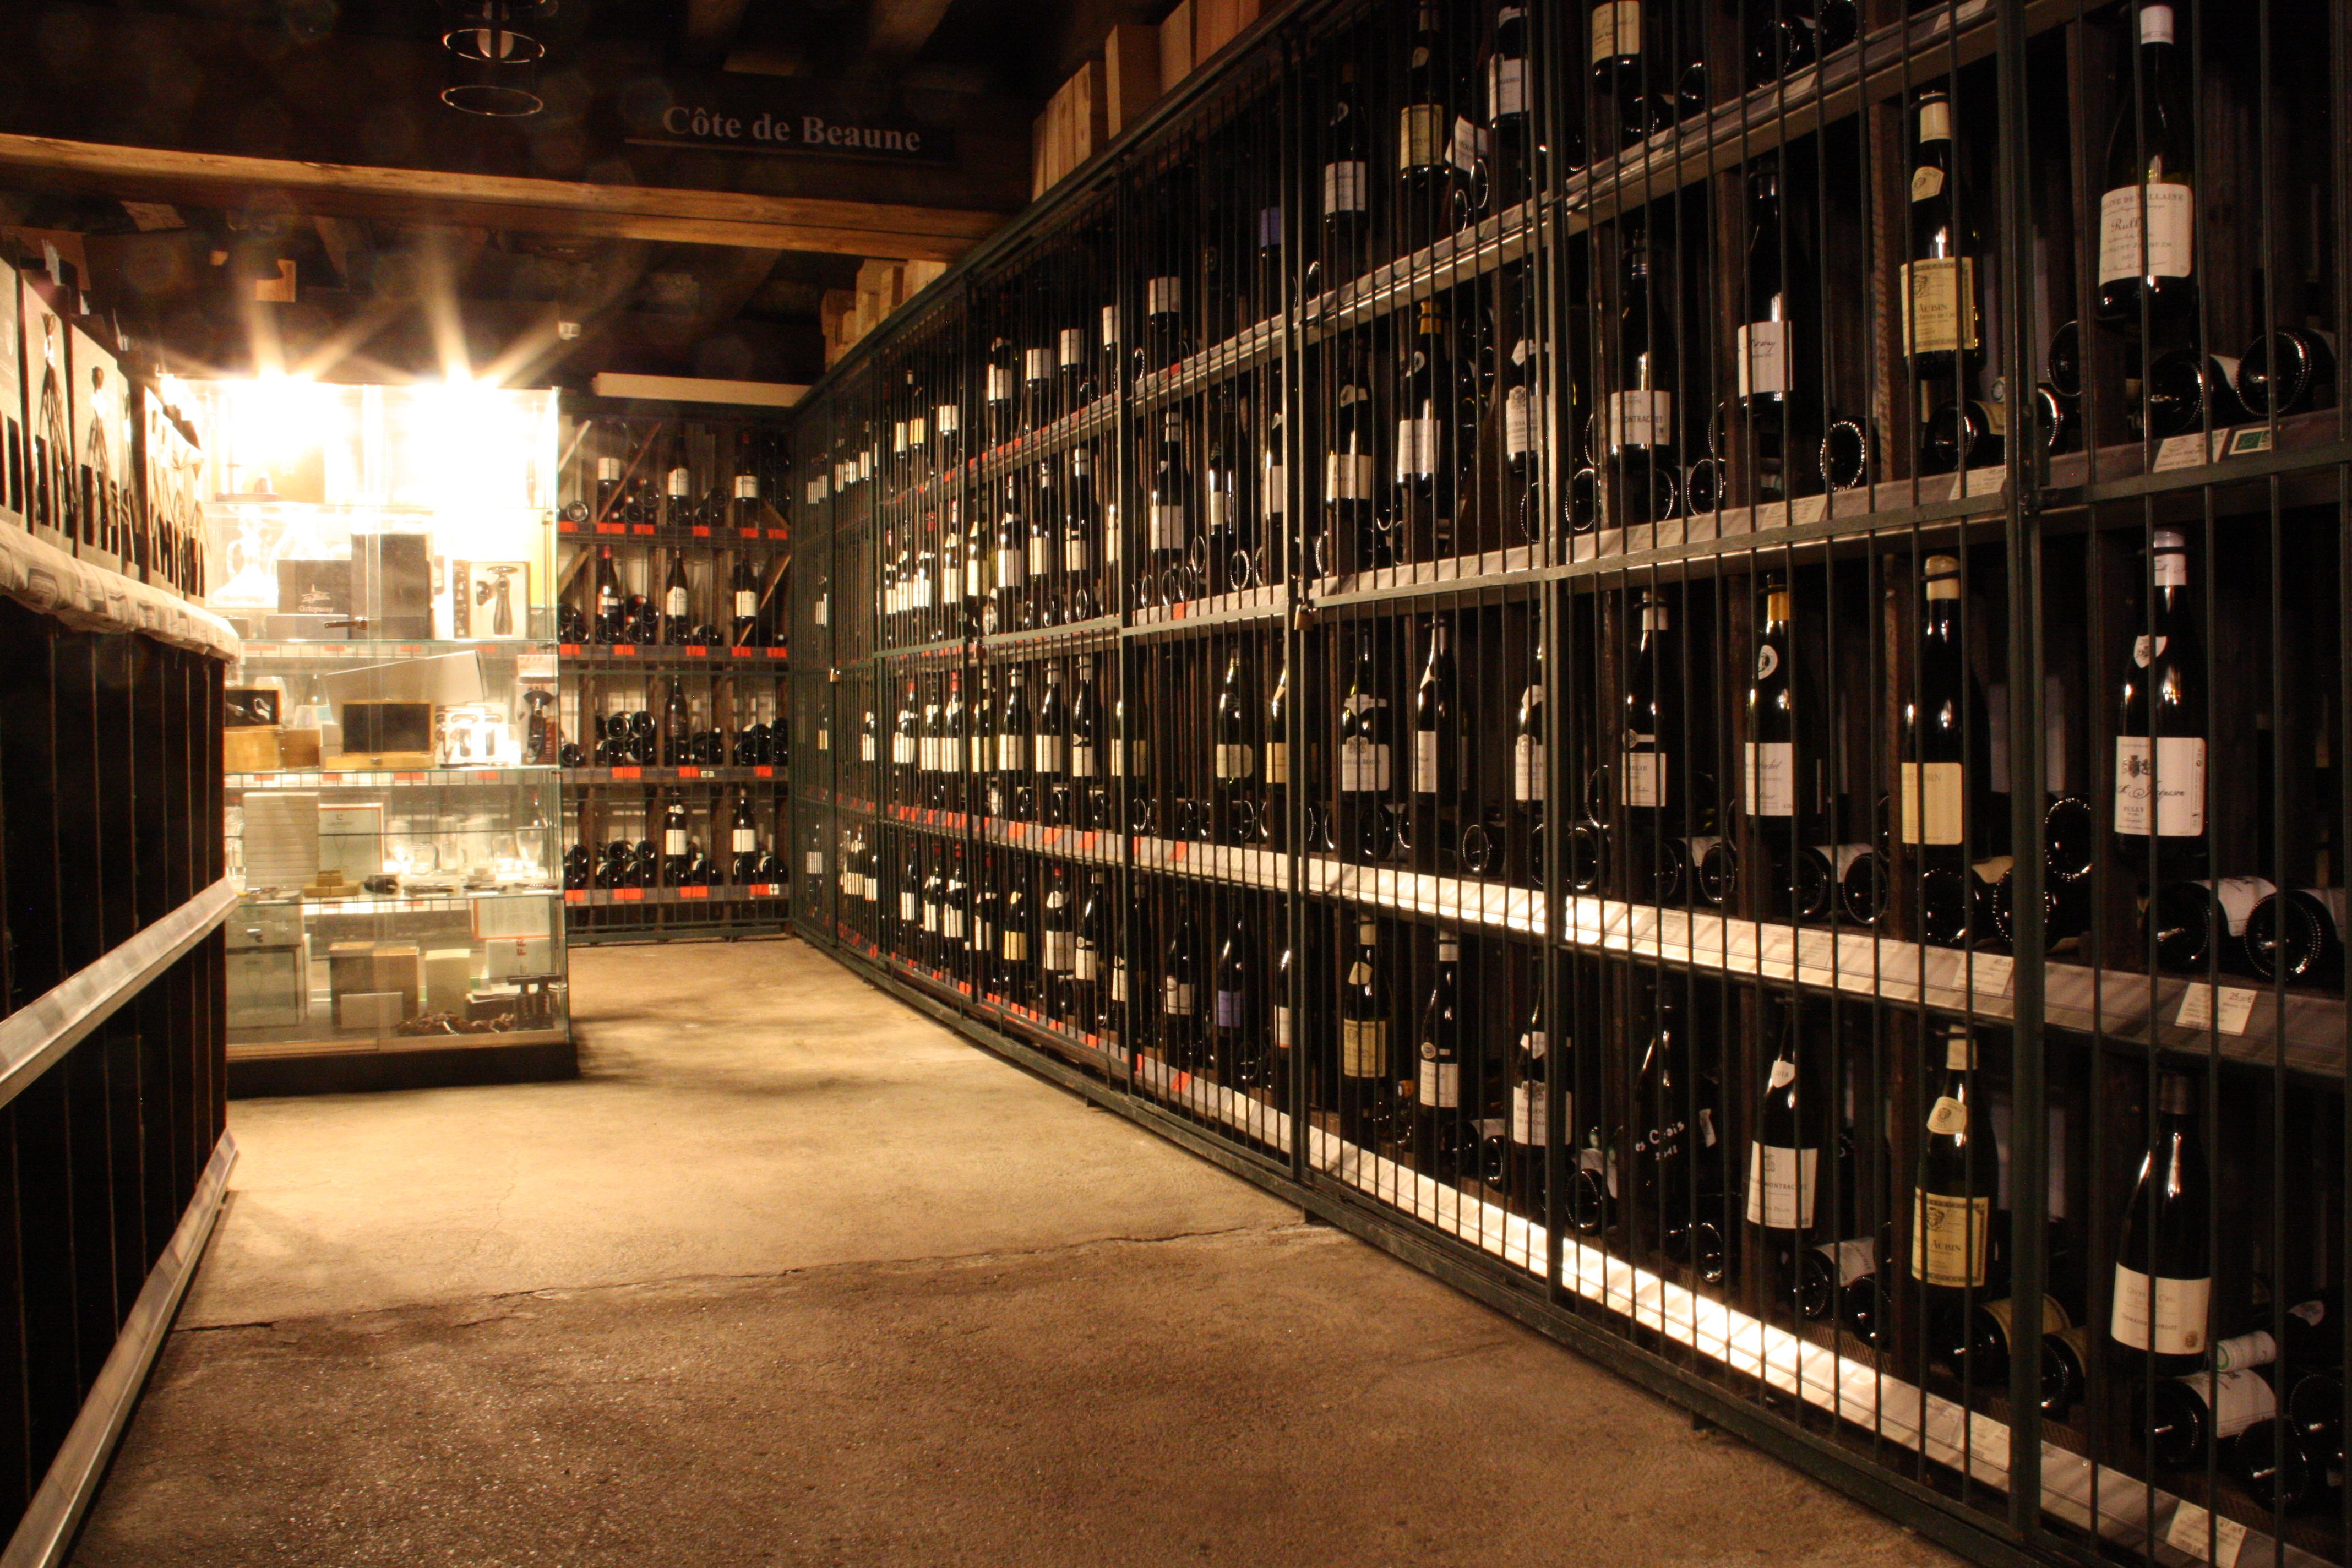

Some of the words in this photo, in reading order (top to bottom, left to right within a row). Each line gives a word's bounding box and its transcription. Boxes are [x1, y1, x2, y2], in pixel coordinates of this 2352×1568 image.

[662, 106, 741, 138] Côte
[752, 113, 790, 141] de
[802, 116, 921, 151] Beaune
